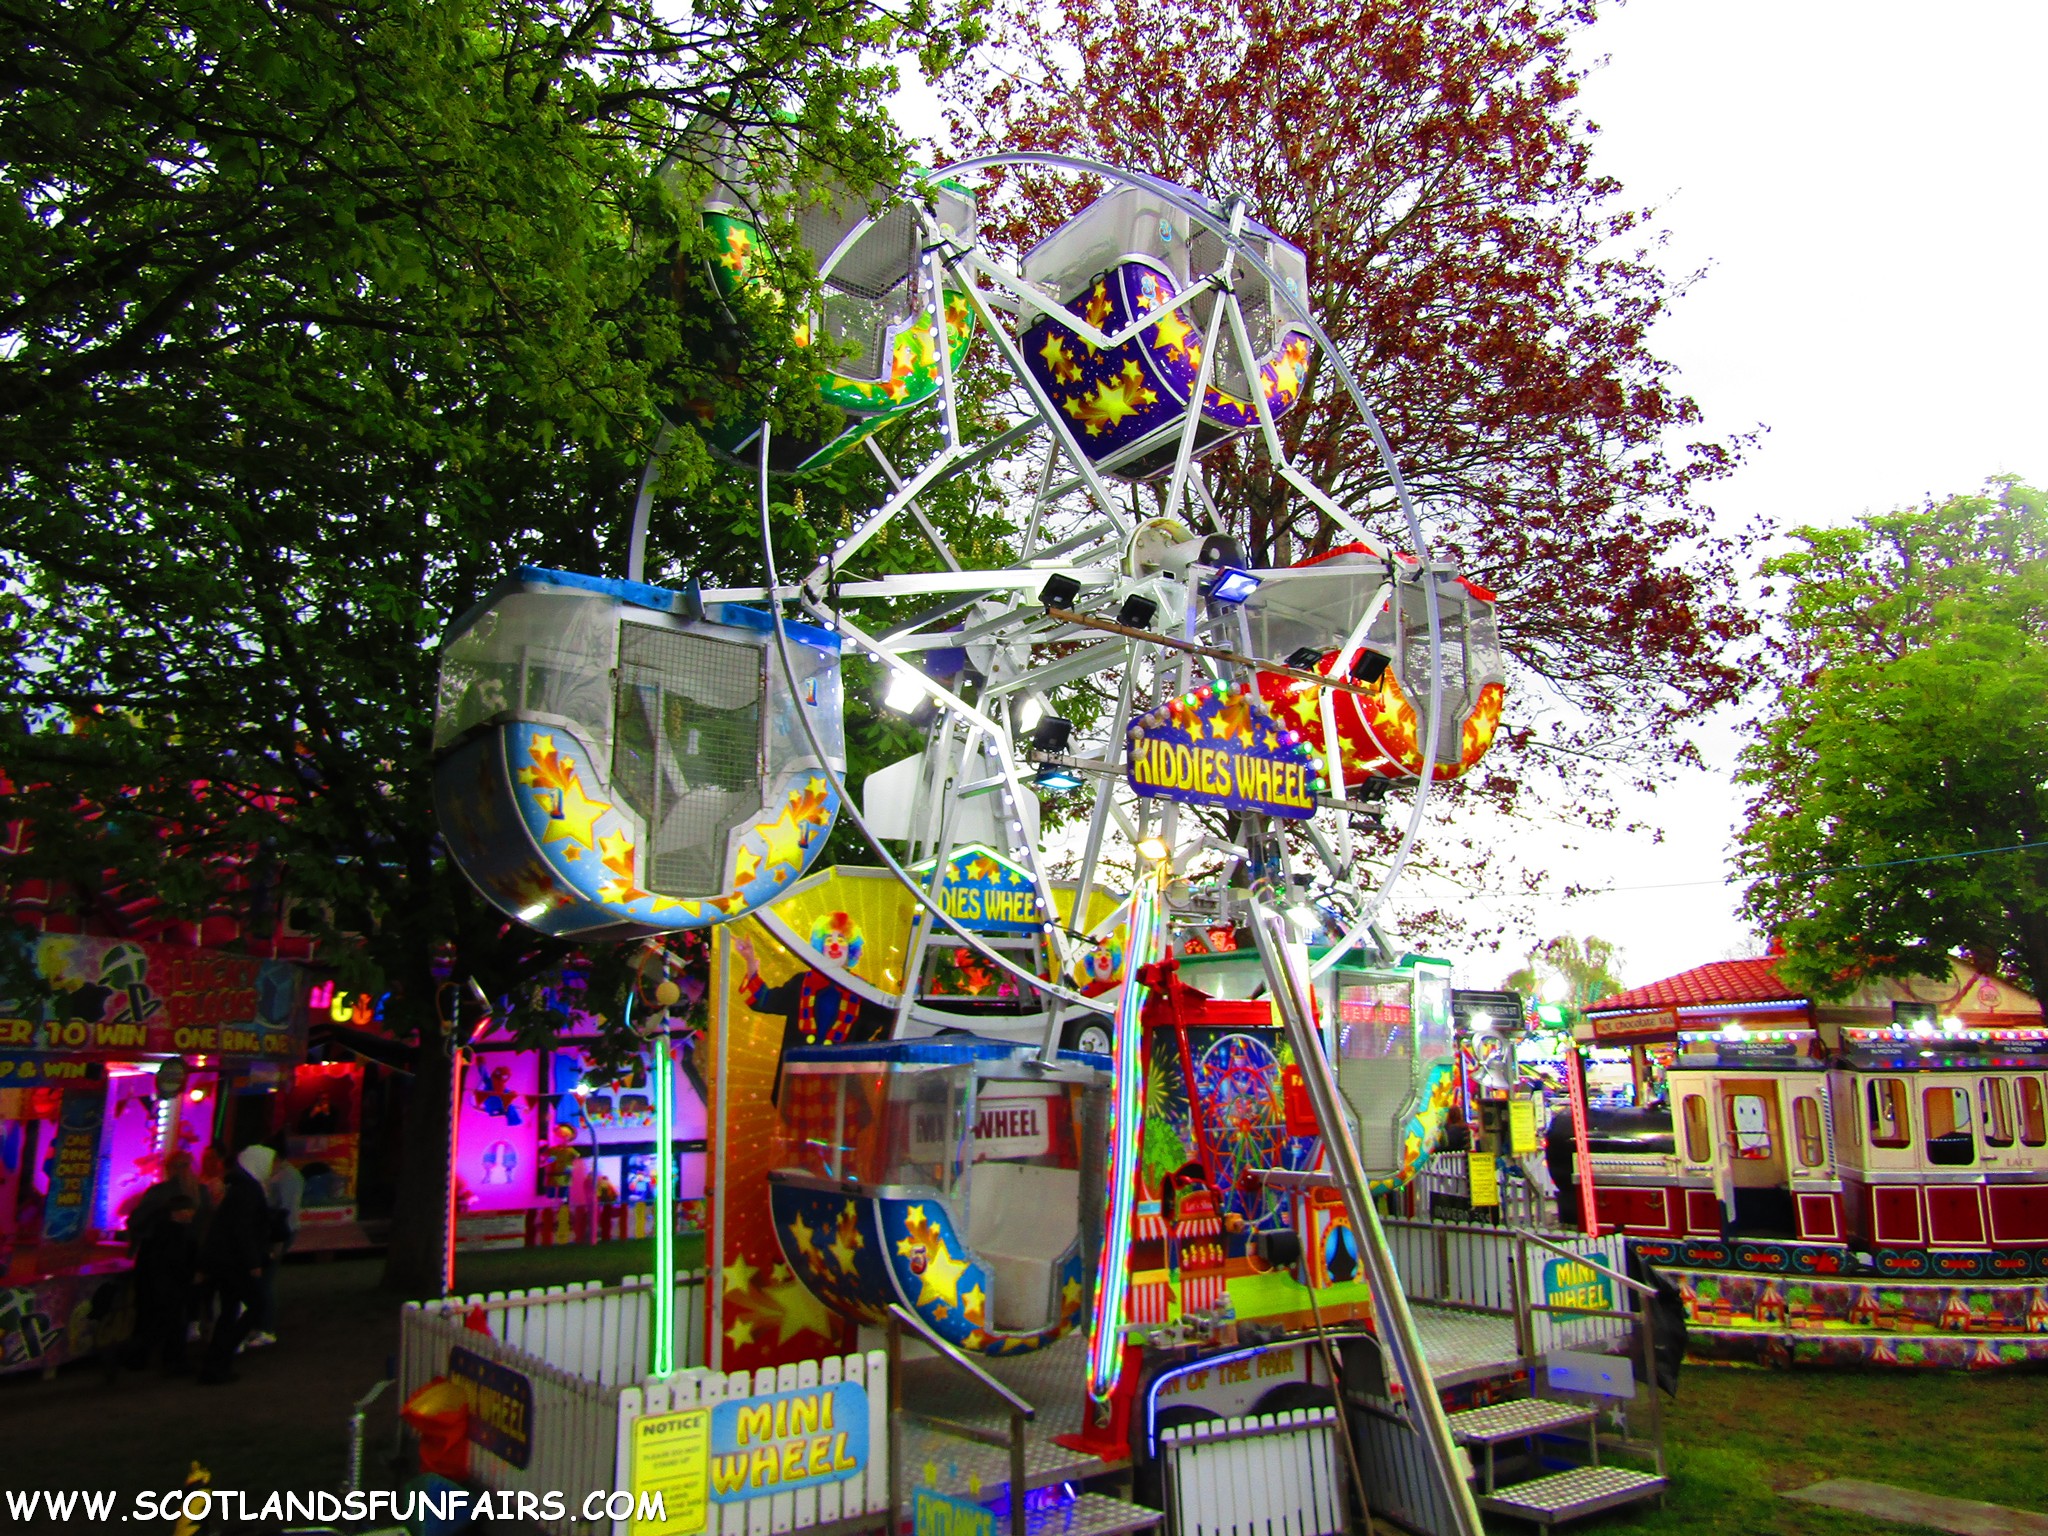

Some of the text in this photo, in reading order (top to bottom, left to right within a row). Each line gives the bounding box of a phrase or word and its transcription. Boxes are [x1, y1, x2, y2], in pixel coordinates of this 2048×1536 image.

[805, 677, 818, 706] 1
[1134, 738, 1314, 809] KIDDIES WHEEL
[551, 787, 565, 820] 1
[939, 886, 981, 920] DIES
[46, 1020, 86, 1046] TO
[97, 1024, 147, 1047] WIN
[43, 1062, 87, 1078] WIN
[975, 1109, 1040, 1139] WHEEL
[1556, 1259, 1597, 1288] MINI
[1549, 1284, 1609, 1317] WHEEL
[1186, 1370, 1210, 1391] OF
[1216, 1359, 1251, 1386] THE
[1257, 1350, 1294, 1377] FAIR
[643, 1416, 700, 1436] NOTICE
[737, 1391, 834, 1446] MINI
[711, 1432, 857, 1495] WHEEL
